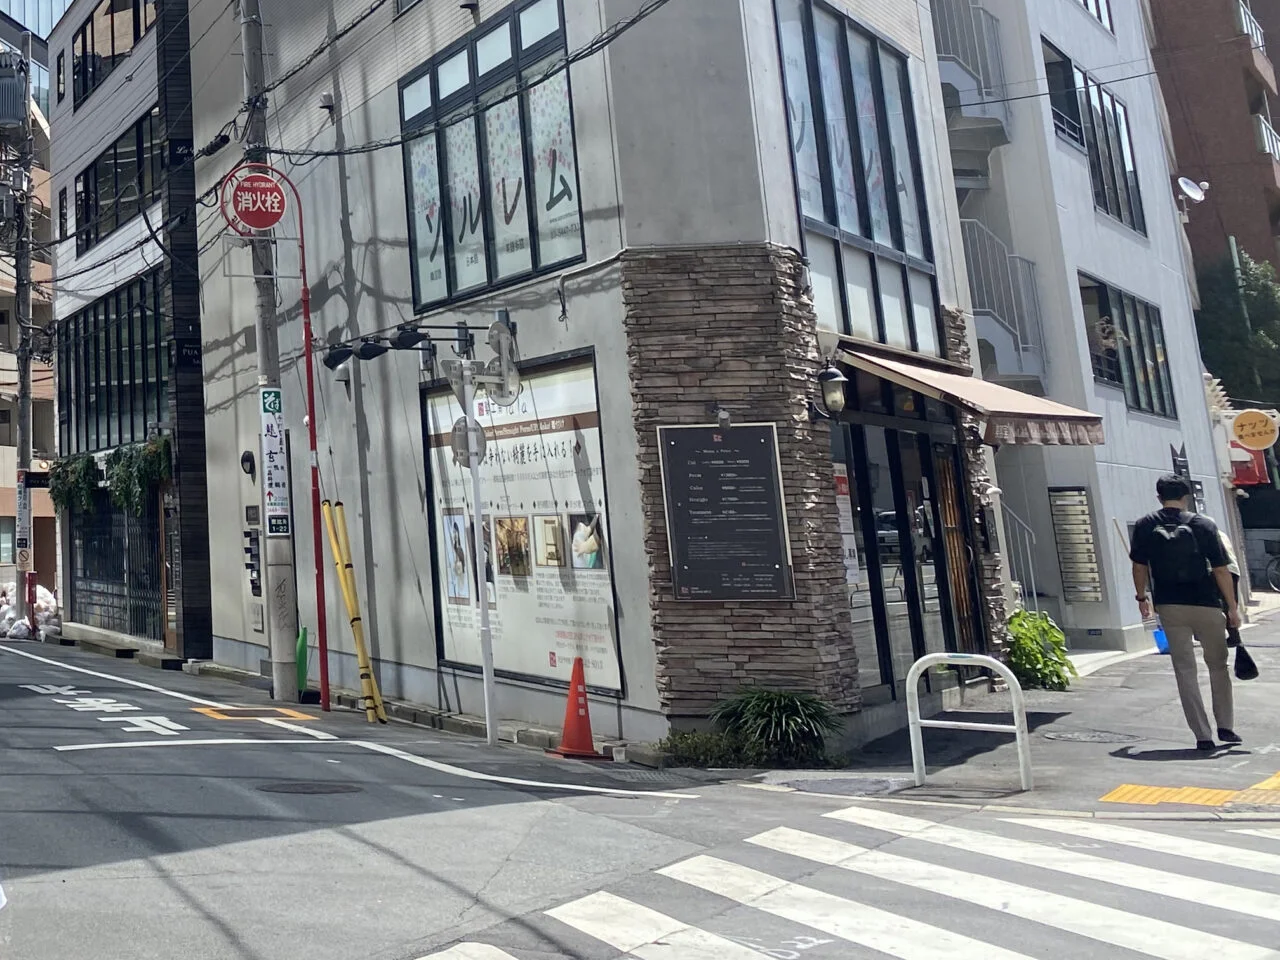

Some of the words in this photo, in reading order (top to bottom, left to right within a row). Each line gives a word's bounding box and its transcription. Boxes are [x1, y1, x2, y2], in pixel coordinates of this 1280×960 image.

[236, 191, 282, 213] 消火栓
[1237, 419, 1268, 432] ナッツ
